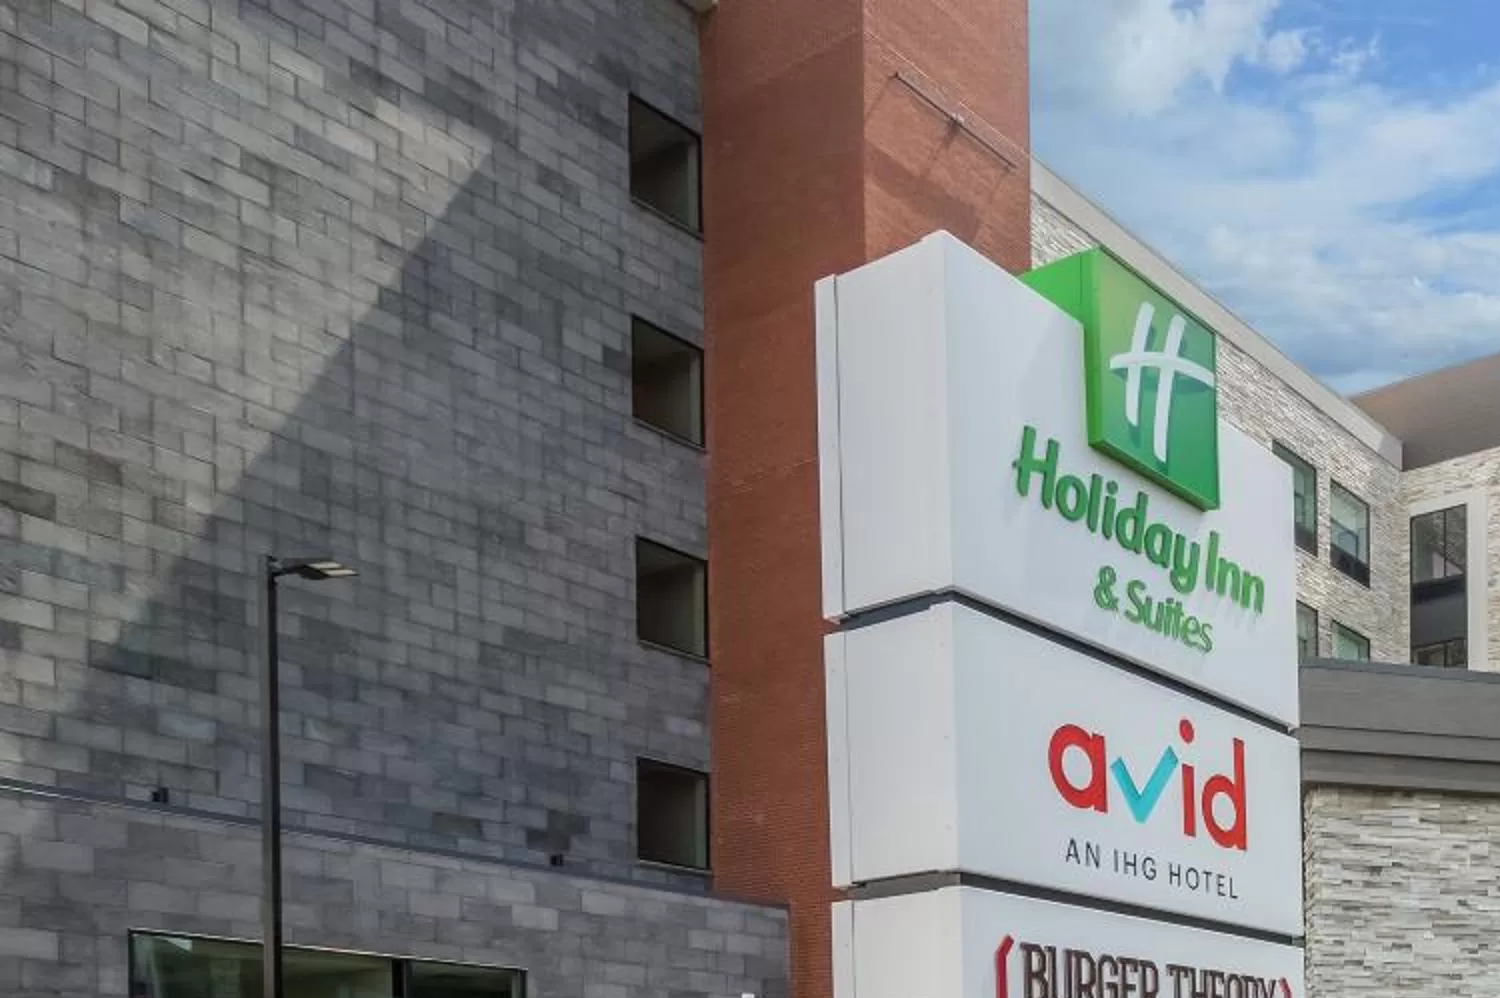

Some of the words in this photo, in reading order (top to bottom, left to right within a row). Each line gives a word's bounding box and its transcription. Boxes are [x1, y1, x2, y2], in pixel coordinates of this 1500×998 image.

[1012, 424, 1200, 590] Holiday
[1205, 531, 1266, 613] Inn
[1093, 564, 1120, 614] &
[1127, 580, 1214, 654] Suites
[1047, 717, 1248, 852] avid
[1064, 838, 1101, 870] AN
[1113, 848, 1158, 882] IHG
[1168, 862, 1240, 900] HOTEL
